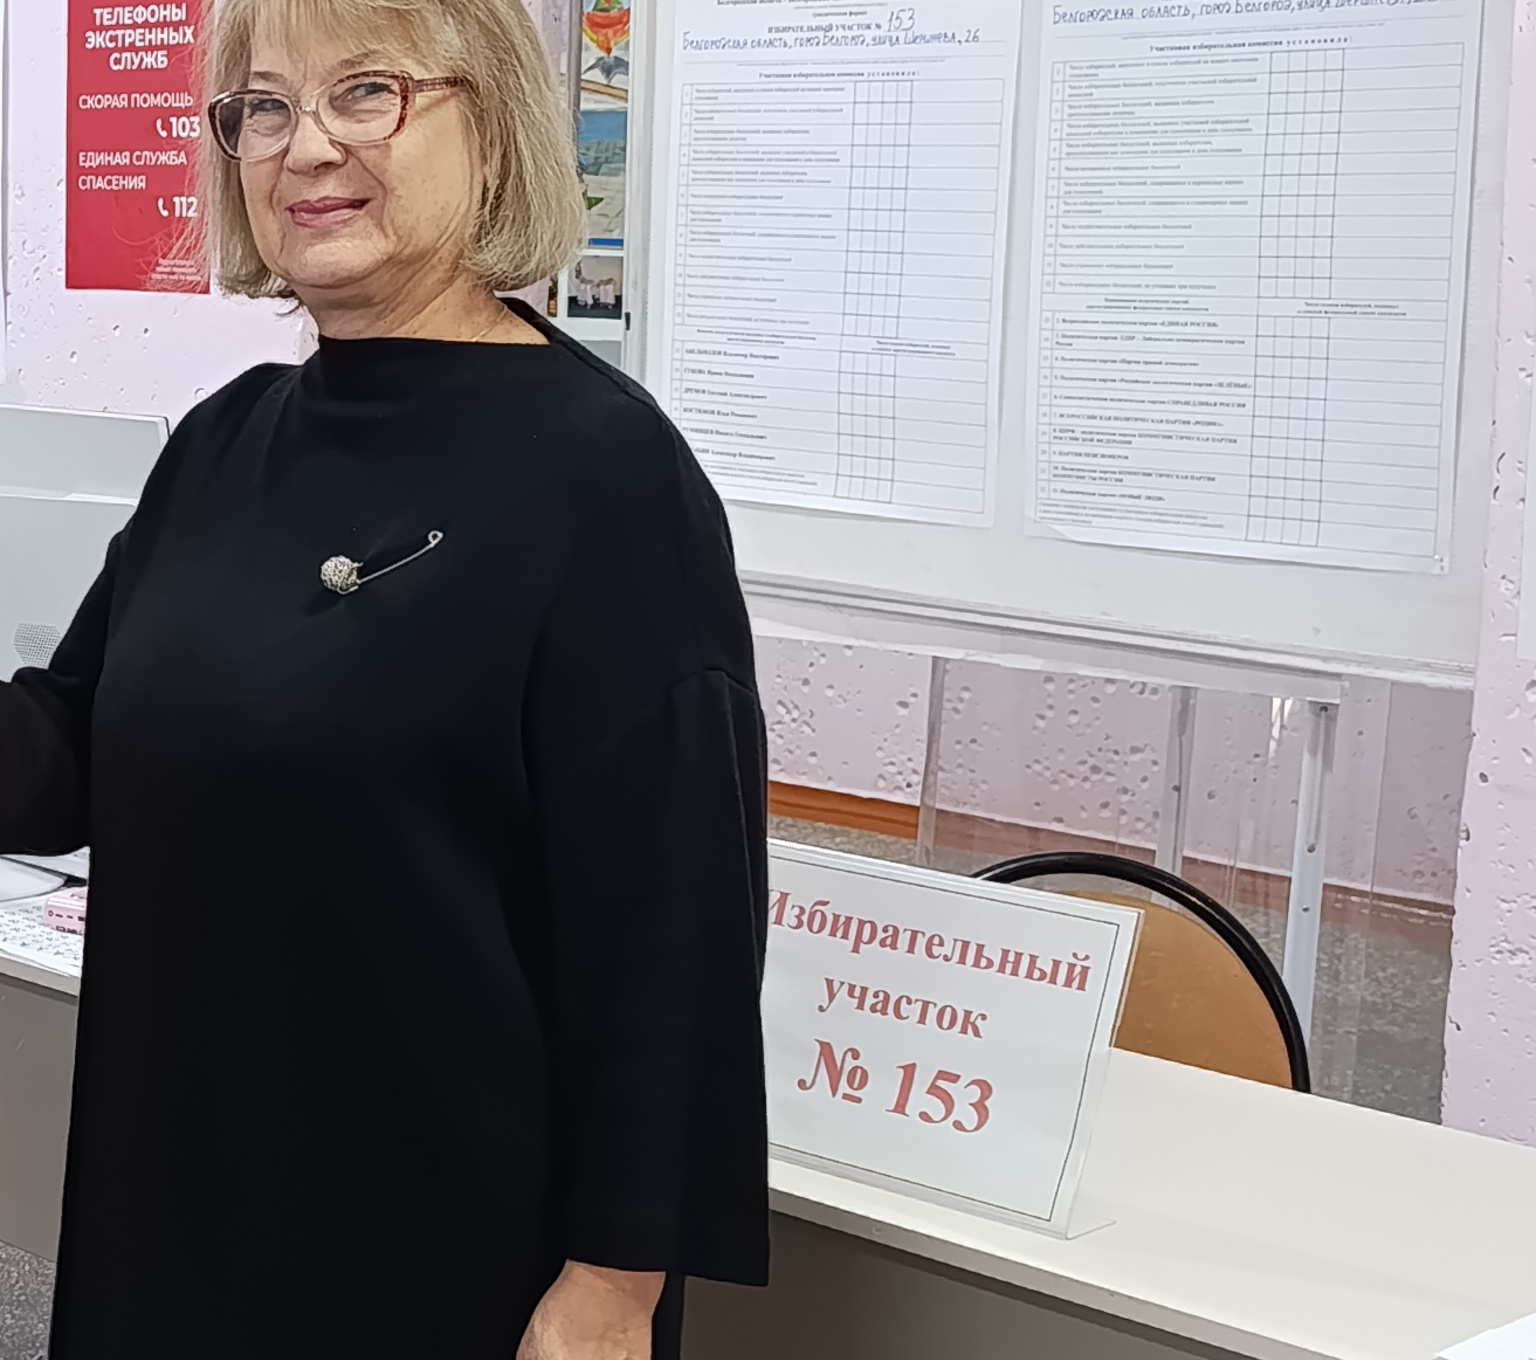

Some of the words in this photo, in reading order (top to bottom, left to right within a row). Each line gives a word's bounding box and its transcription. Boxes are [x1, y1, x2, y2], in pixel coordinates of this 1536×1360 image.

[93, 2, 187, 26] ТЕЛЕФОНЫ
[887, 7, 916, 33] 153
[84, 25, 195, 50] ЭКСТРЕННЫХ
[964, 28, 981, 43] 26
[109, 50, 169, 71] СЛУЖБ
[78, 93, 128, 110] СКОРАЯ
[131, 92, 193, 110] ПОМОЩЬ
[169, 115, 201, 138] 103
[78, 151, 131, 168] ЕДИНАЯ
[133, 150, 188, 168] СЛУЖБА
[78, 175, 146, 191] СПАСЕНИЯ
[172, 196, 198, 219] 112
[769, 888, 1093, 993] Избирательный
[817, 976, 989, 1039] участок
[796, 1038, 870, 1104] №
[884, 1061, 995, 1134] 153
